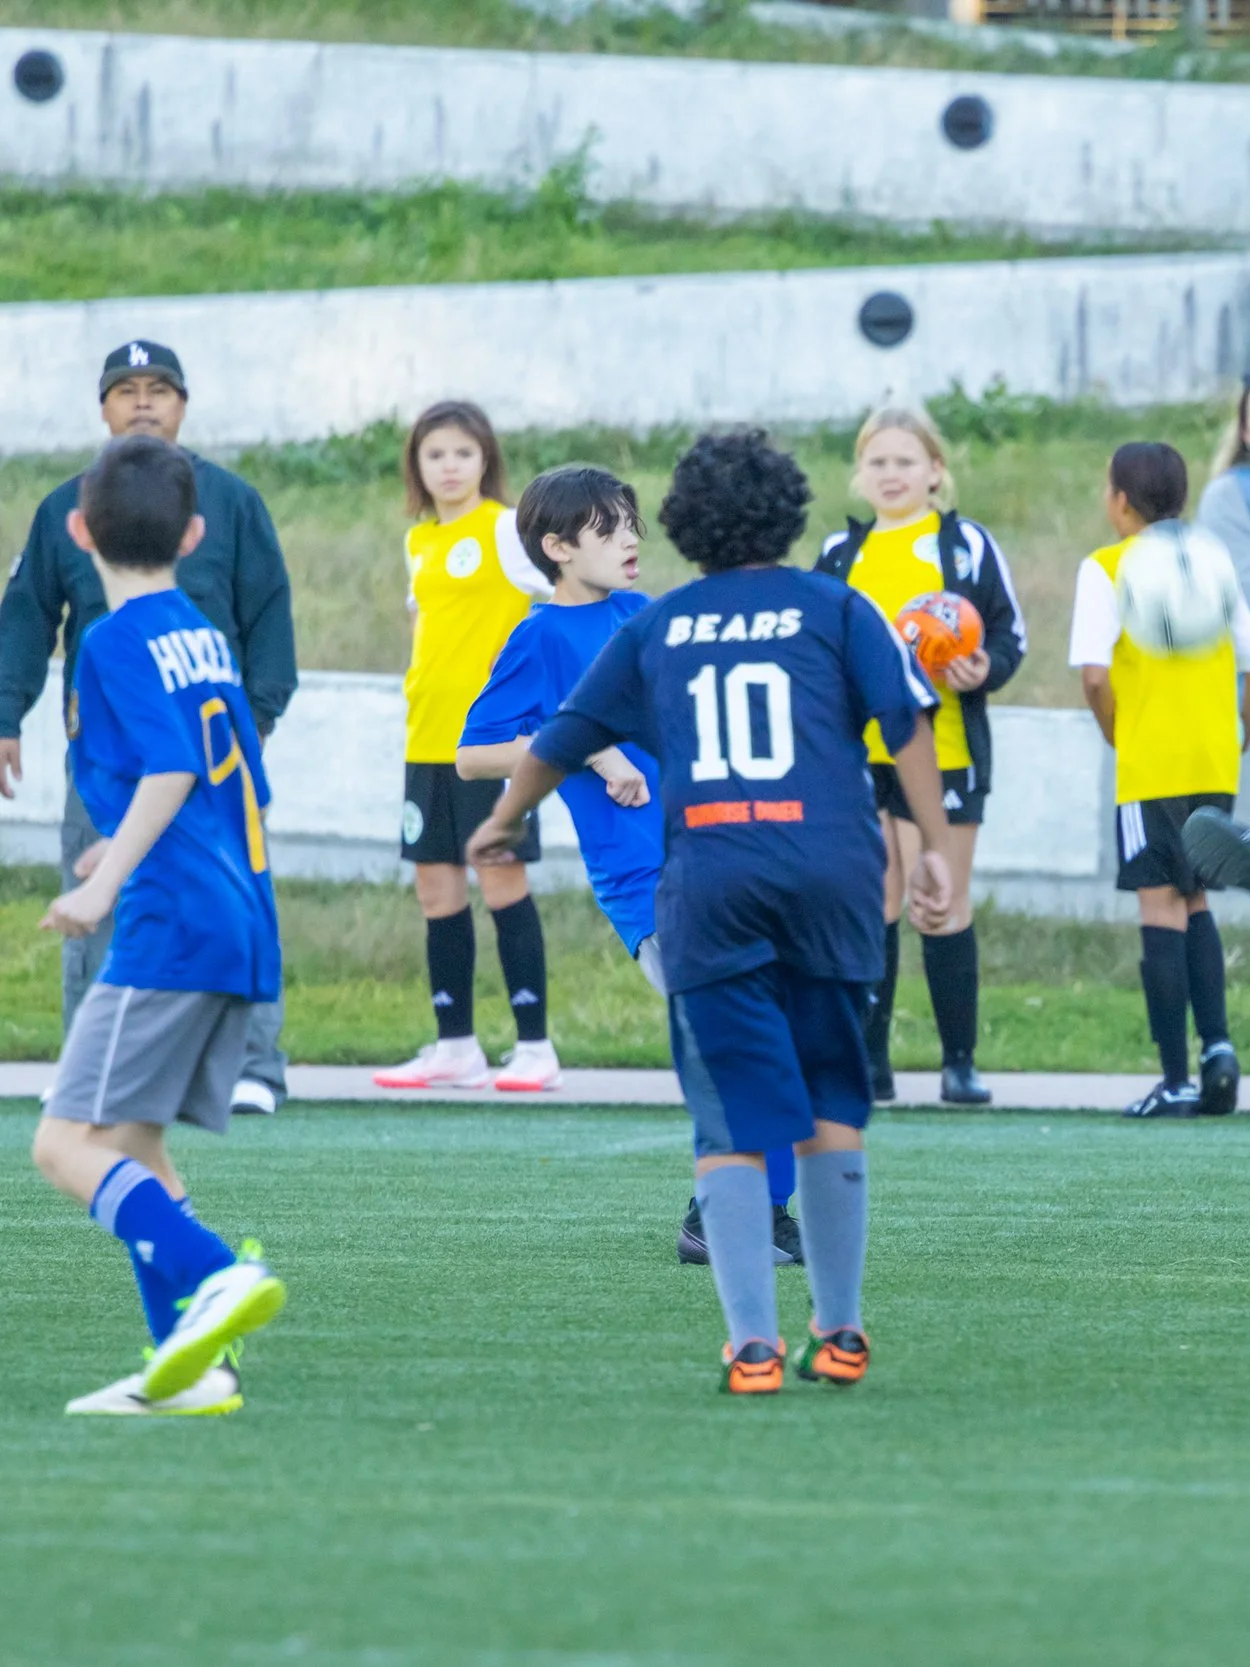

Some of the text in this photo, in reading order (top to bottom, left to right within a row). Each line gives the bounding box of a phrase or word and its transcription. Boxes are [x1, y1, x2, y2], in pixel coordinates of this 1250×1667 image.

[129, 343, 149, 367] LA
[665, 608, 803, 647] BEARS
[687, 661, 795, 783] 10
[200, 697, 268, 874] 9
